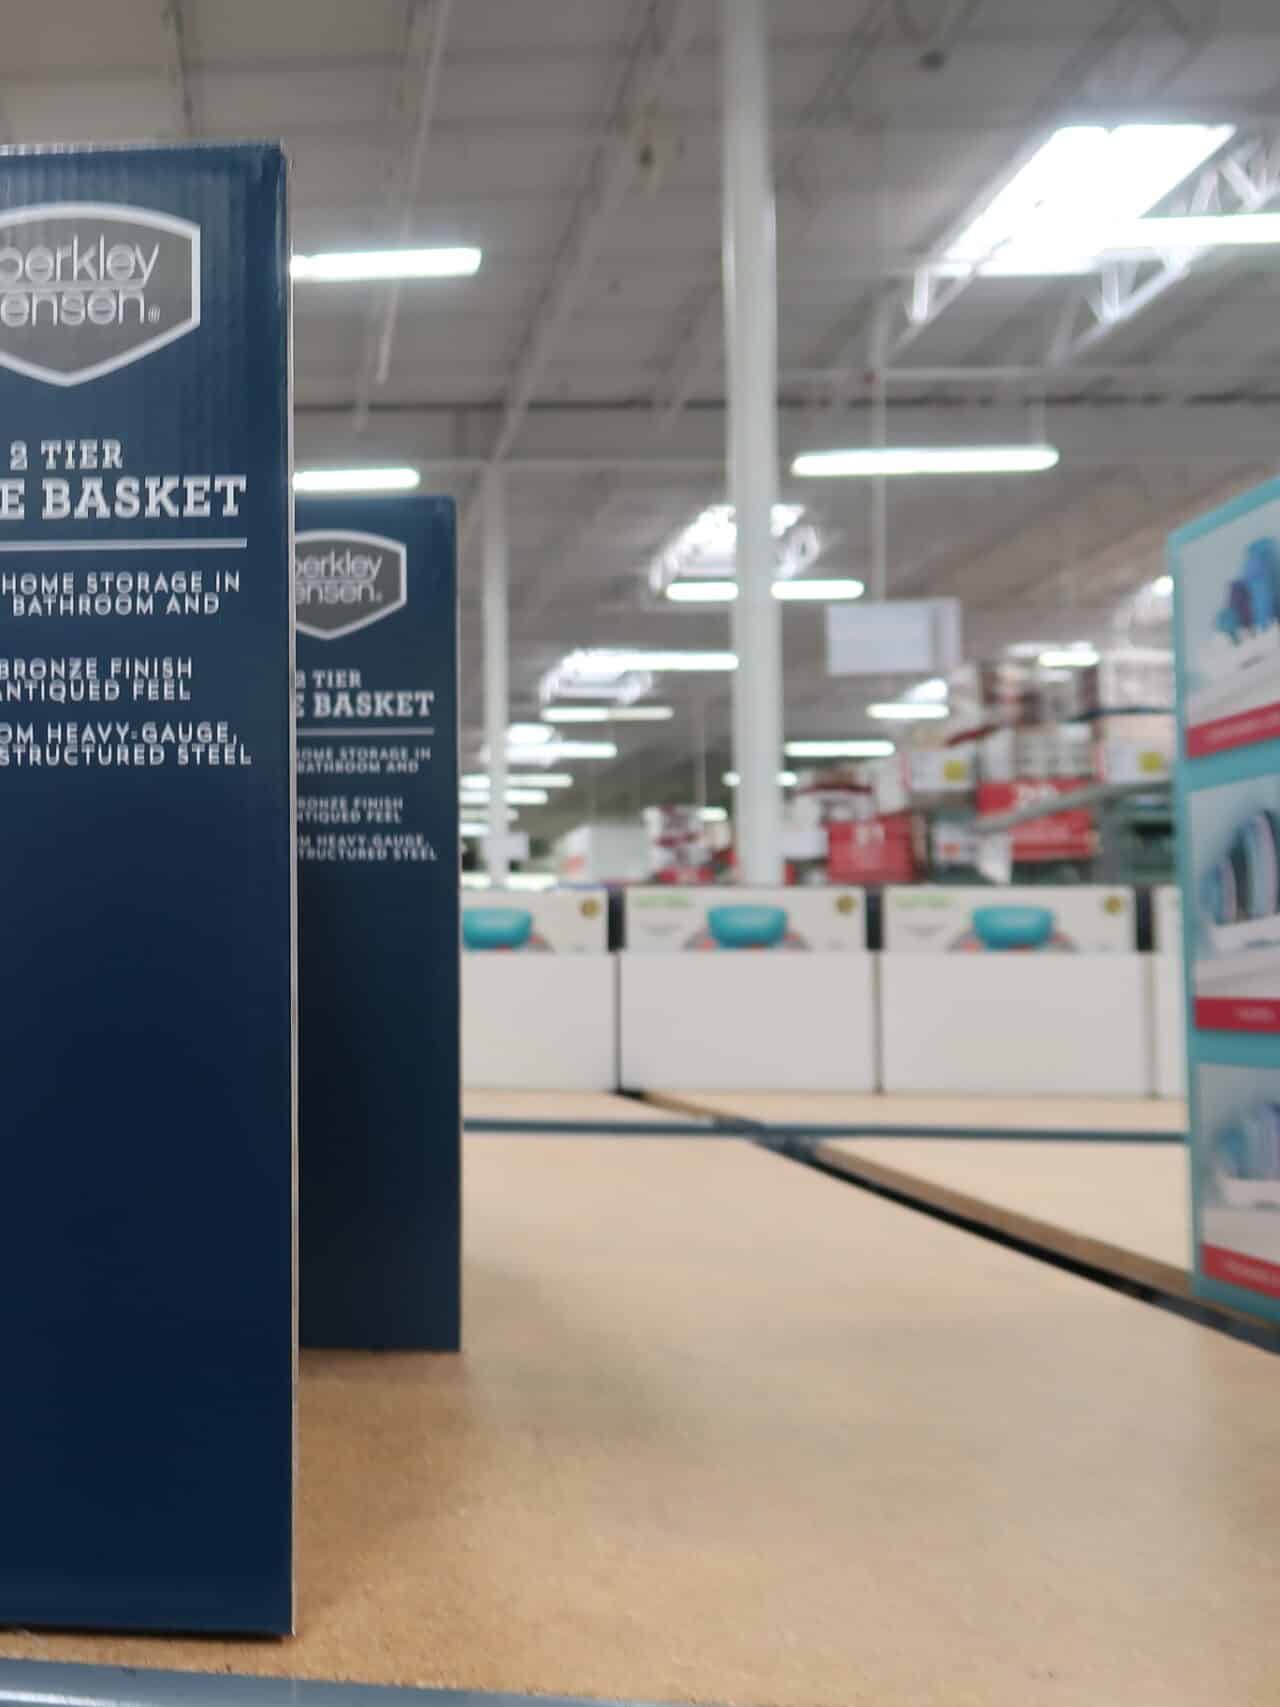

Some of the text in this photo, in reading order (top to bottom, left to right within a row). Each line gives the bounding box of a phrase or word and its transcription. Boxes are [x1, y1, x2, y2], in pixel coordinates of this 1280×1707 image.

[9, 439, 123, 471] 2 TIER
[42, 474, 247, 520] BASKET
[1, 571, 75, 596] HOME
[86, 570, 203, 594] STORAGE
[216, 570, 240, 593] IN
[13, 594, 154, 617] BATHROOM
[166, 592, 220, 616] AND
[110, 656, 193, 680] FINISH
[312, 669, 362, 689] TIER
[133, 679, 192, 702] FEEL
[313, 690, 435, 718] BASKET
[176, 742, 253, 767] STEEL
